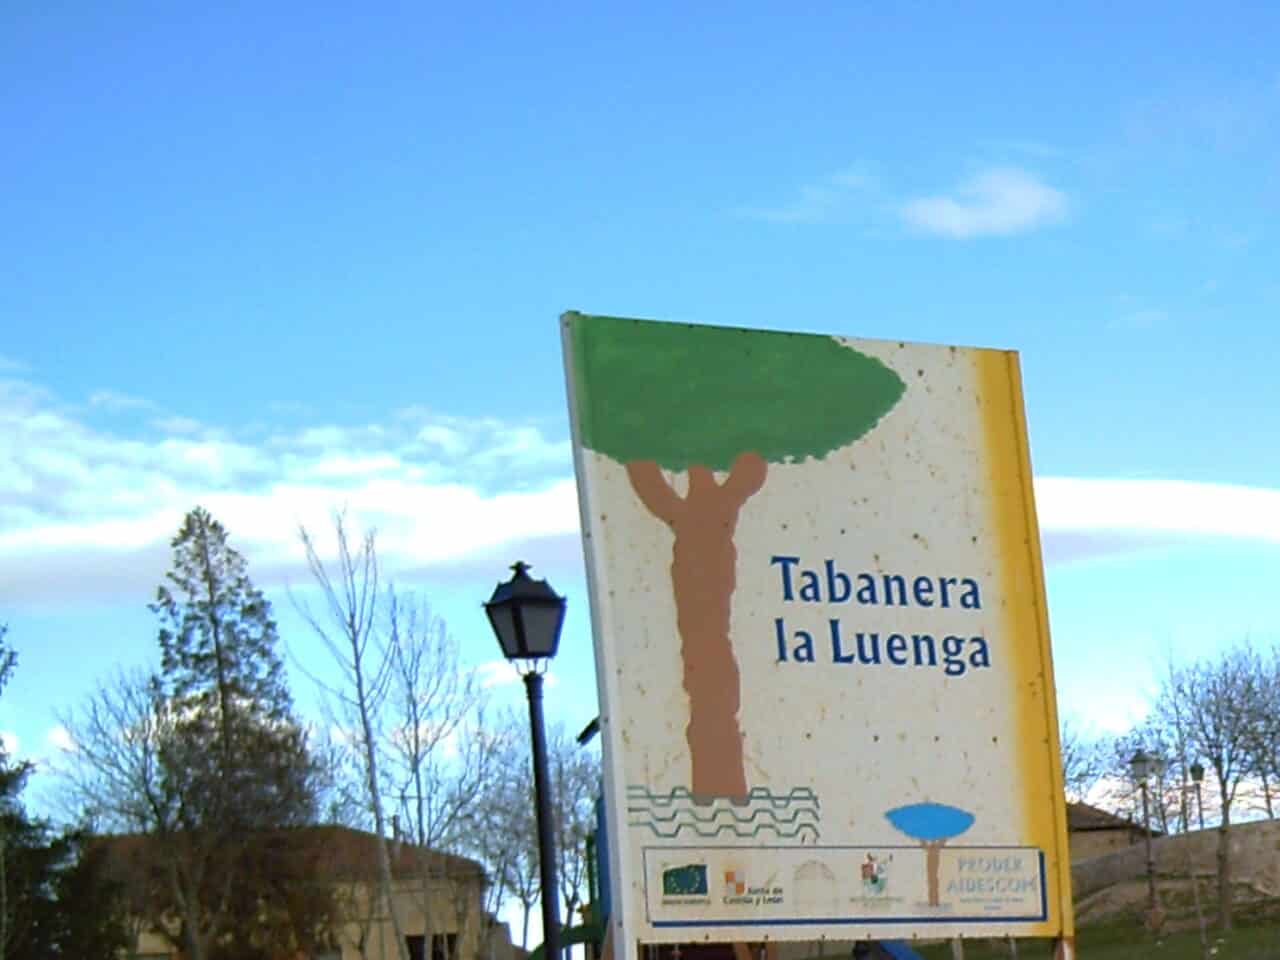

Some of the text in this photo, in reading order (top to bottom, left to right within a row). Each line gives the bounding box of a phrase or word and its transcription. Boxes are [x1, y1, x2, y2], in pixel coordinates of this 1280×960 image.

[770, 555, 981, 609] Tabanera
[775, 617, 990, 677] la Luenga
